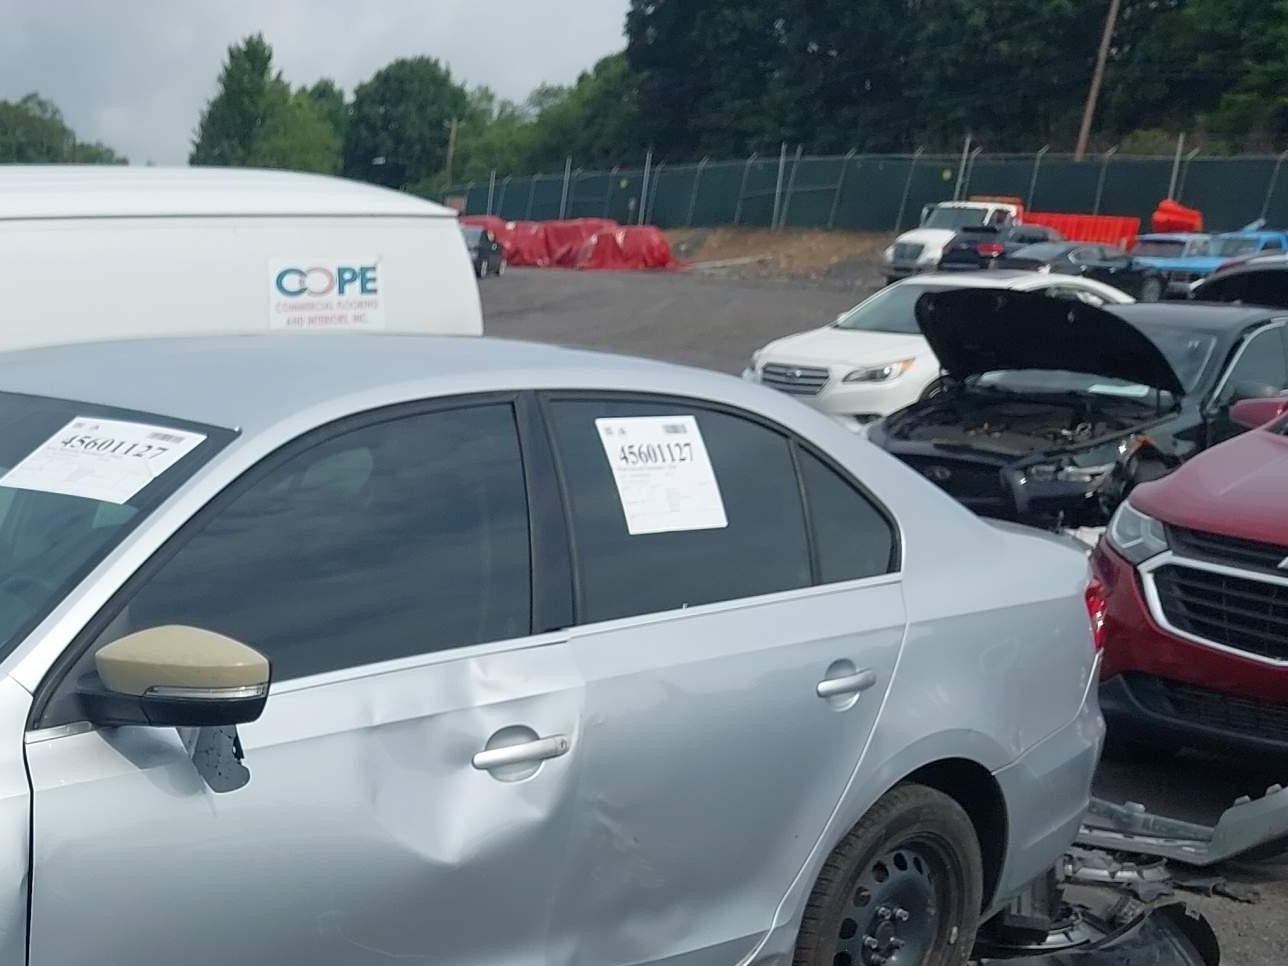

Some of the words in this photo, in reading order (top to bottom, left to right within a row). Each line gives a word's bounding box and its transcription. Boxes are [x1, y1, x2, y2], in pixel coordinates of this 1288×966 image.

[276, 266, 378, 297] COPE
[60, 434, 169, 460] 45601127
[618, 442, 695, 465] 45601127
